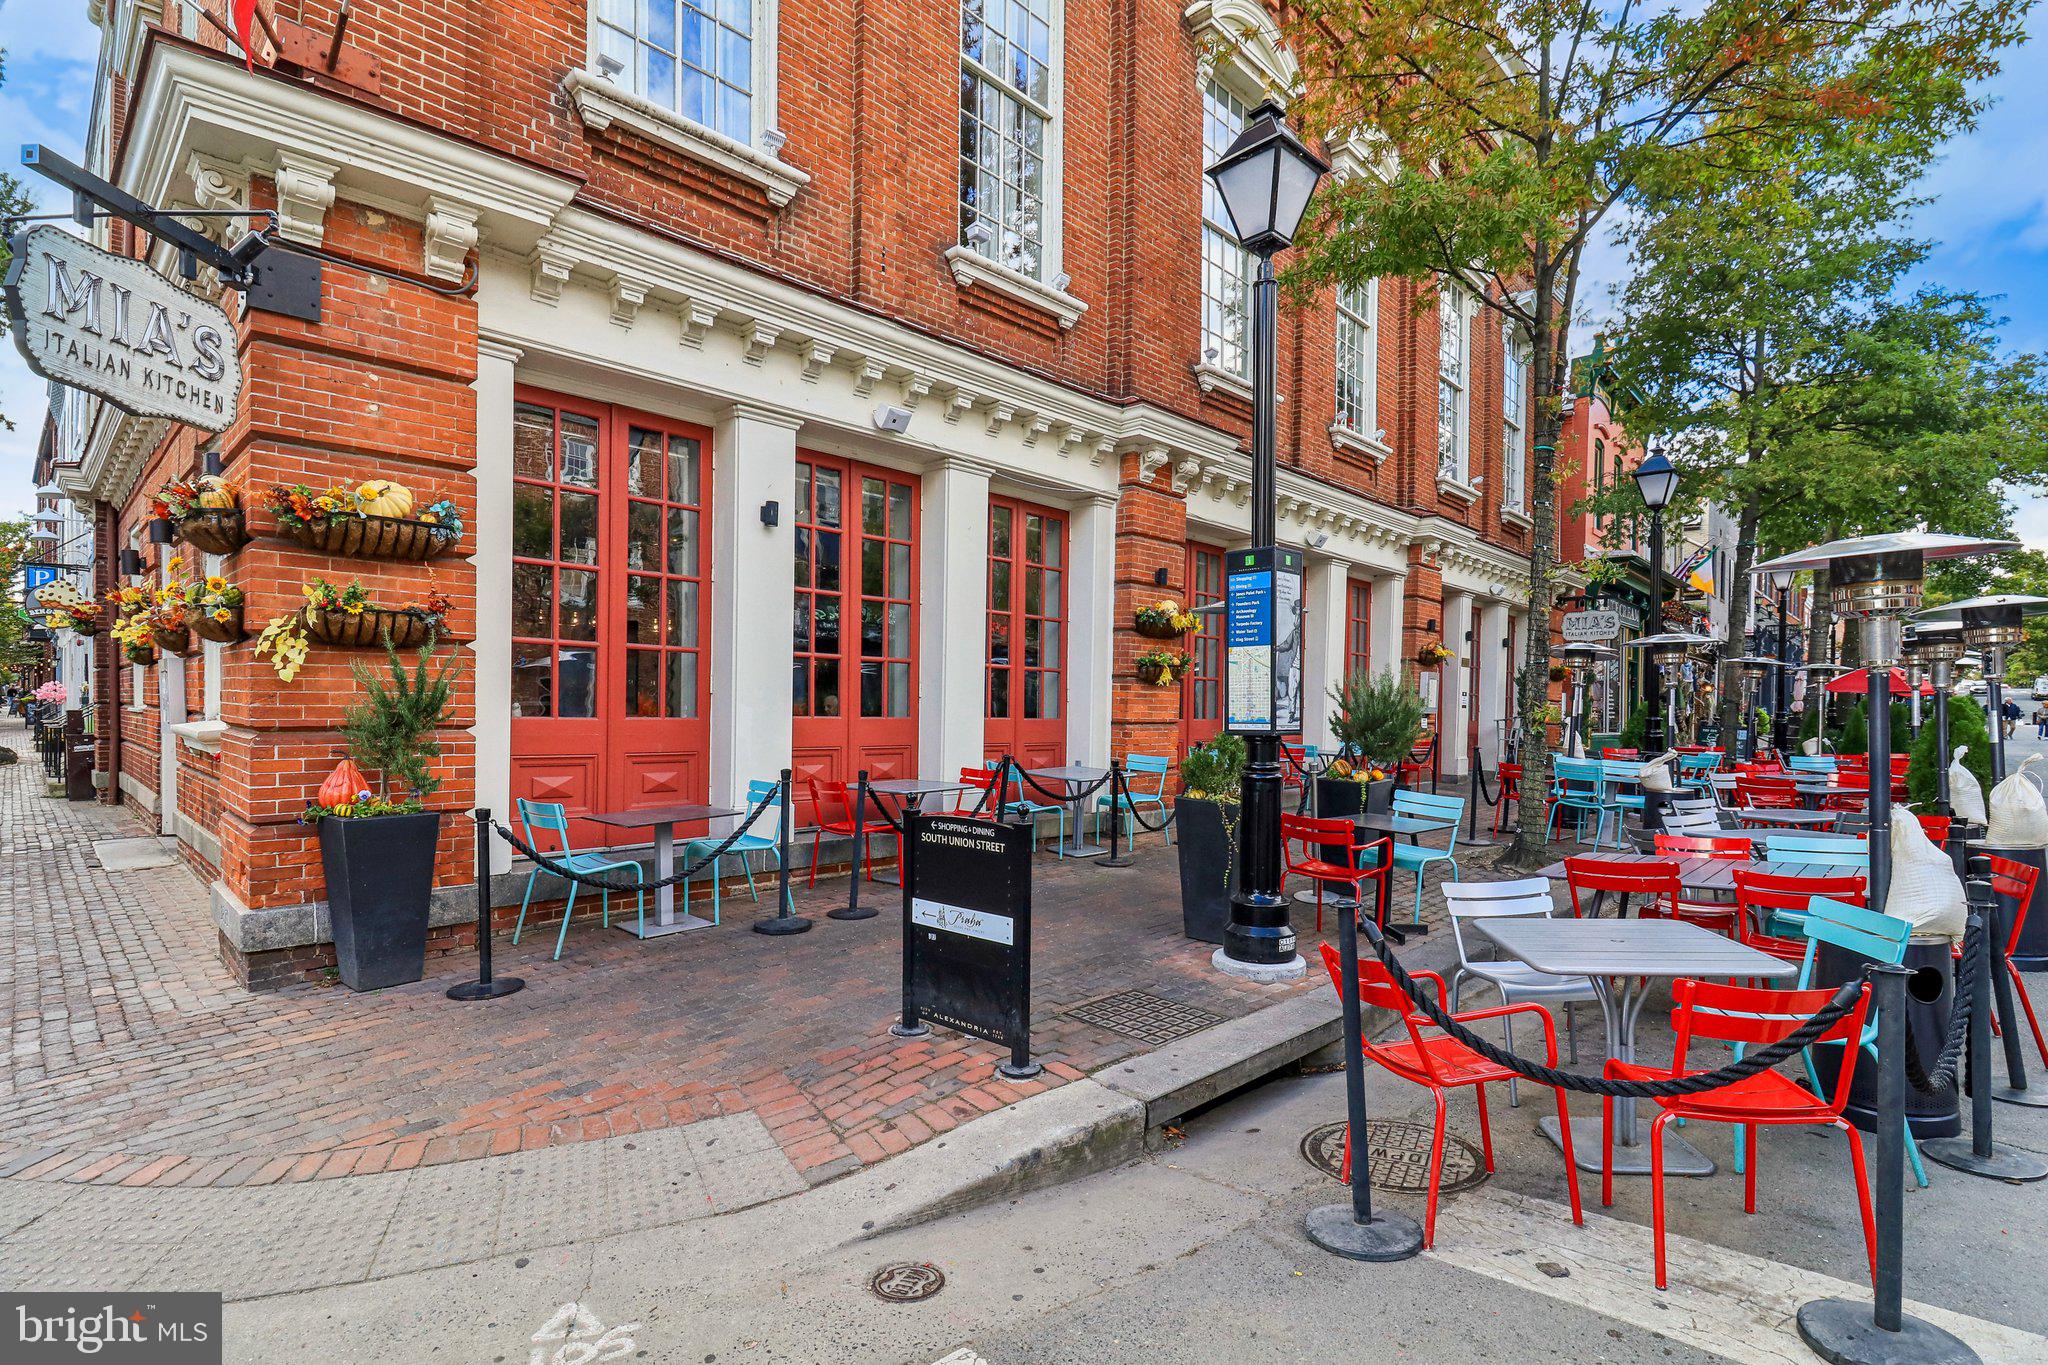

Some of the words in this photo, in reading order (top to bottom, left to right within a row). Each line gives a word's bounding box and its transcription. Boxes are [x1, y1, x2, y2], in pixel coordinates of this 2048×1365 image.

[43, 252, 225, 382] MIA'S
[44, 329, 131, 381] ITALIAN
[142, 366, 225, 414] KITCHEN
[35, 570, 50, 586] P
[1566, 616, 1616, 630] MIA'S
[938, 821, 968, 834] SHOPPING
[972, 826, 995, 837] DINING
[921, 832, 948, 844] SOUTH
[949, 836, 975, 849] UNION
[976, 840, 1005, 853] STREET
[933, 1012, 989, 1035] ALEXANDRIA
[1371, 1148, 1422, 1164] DPW
